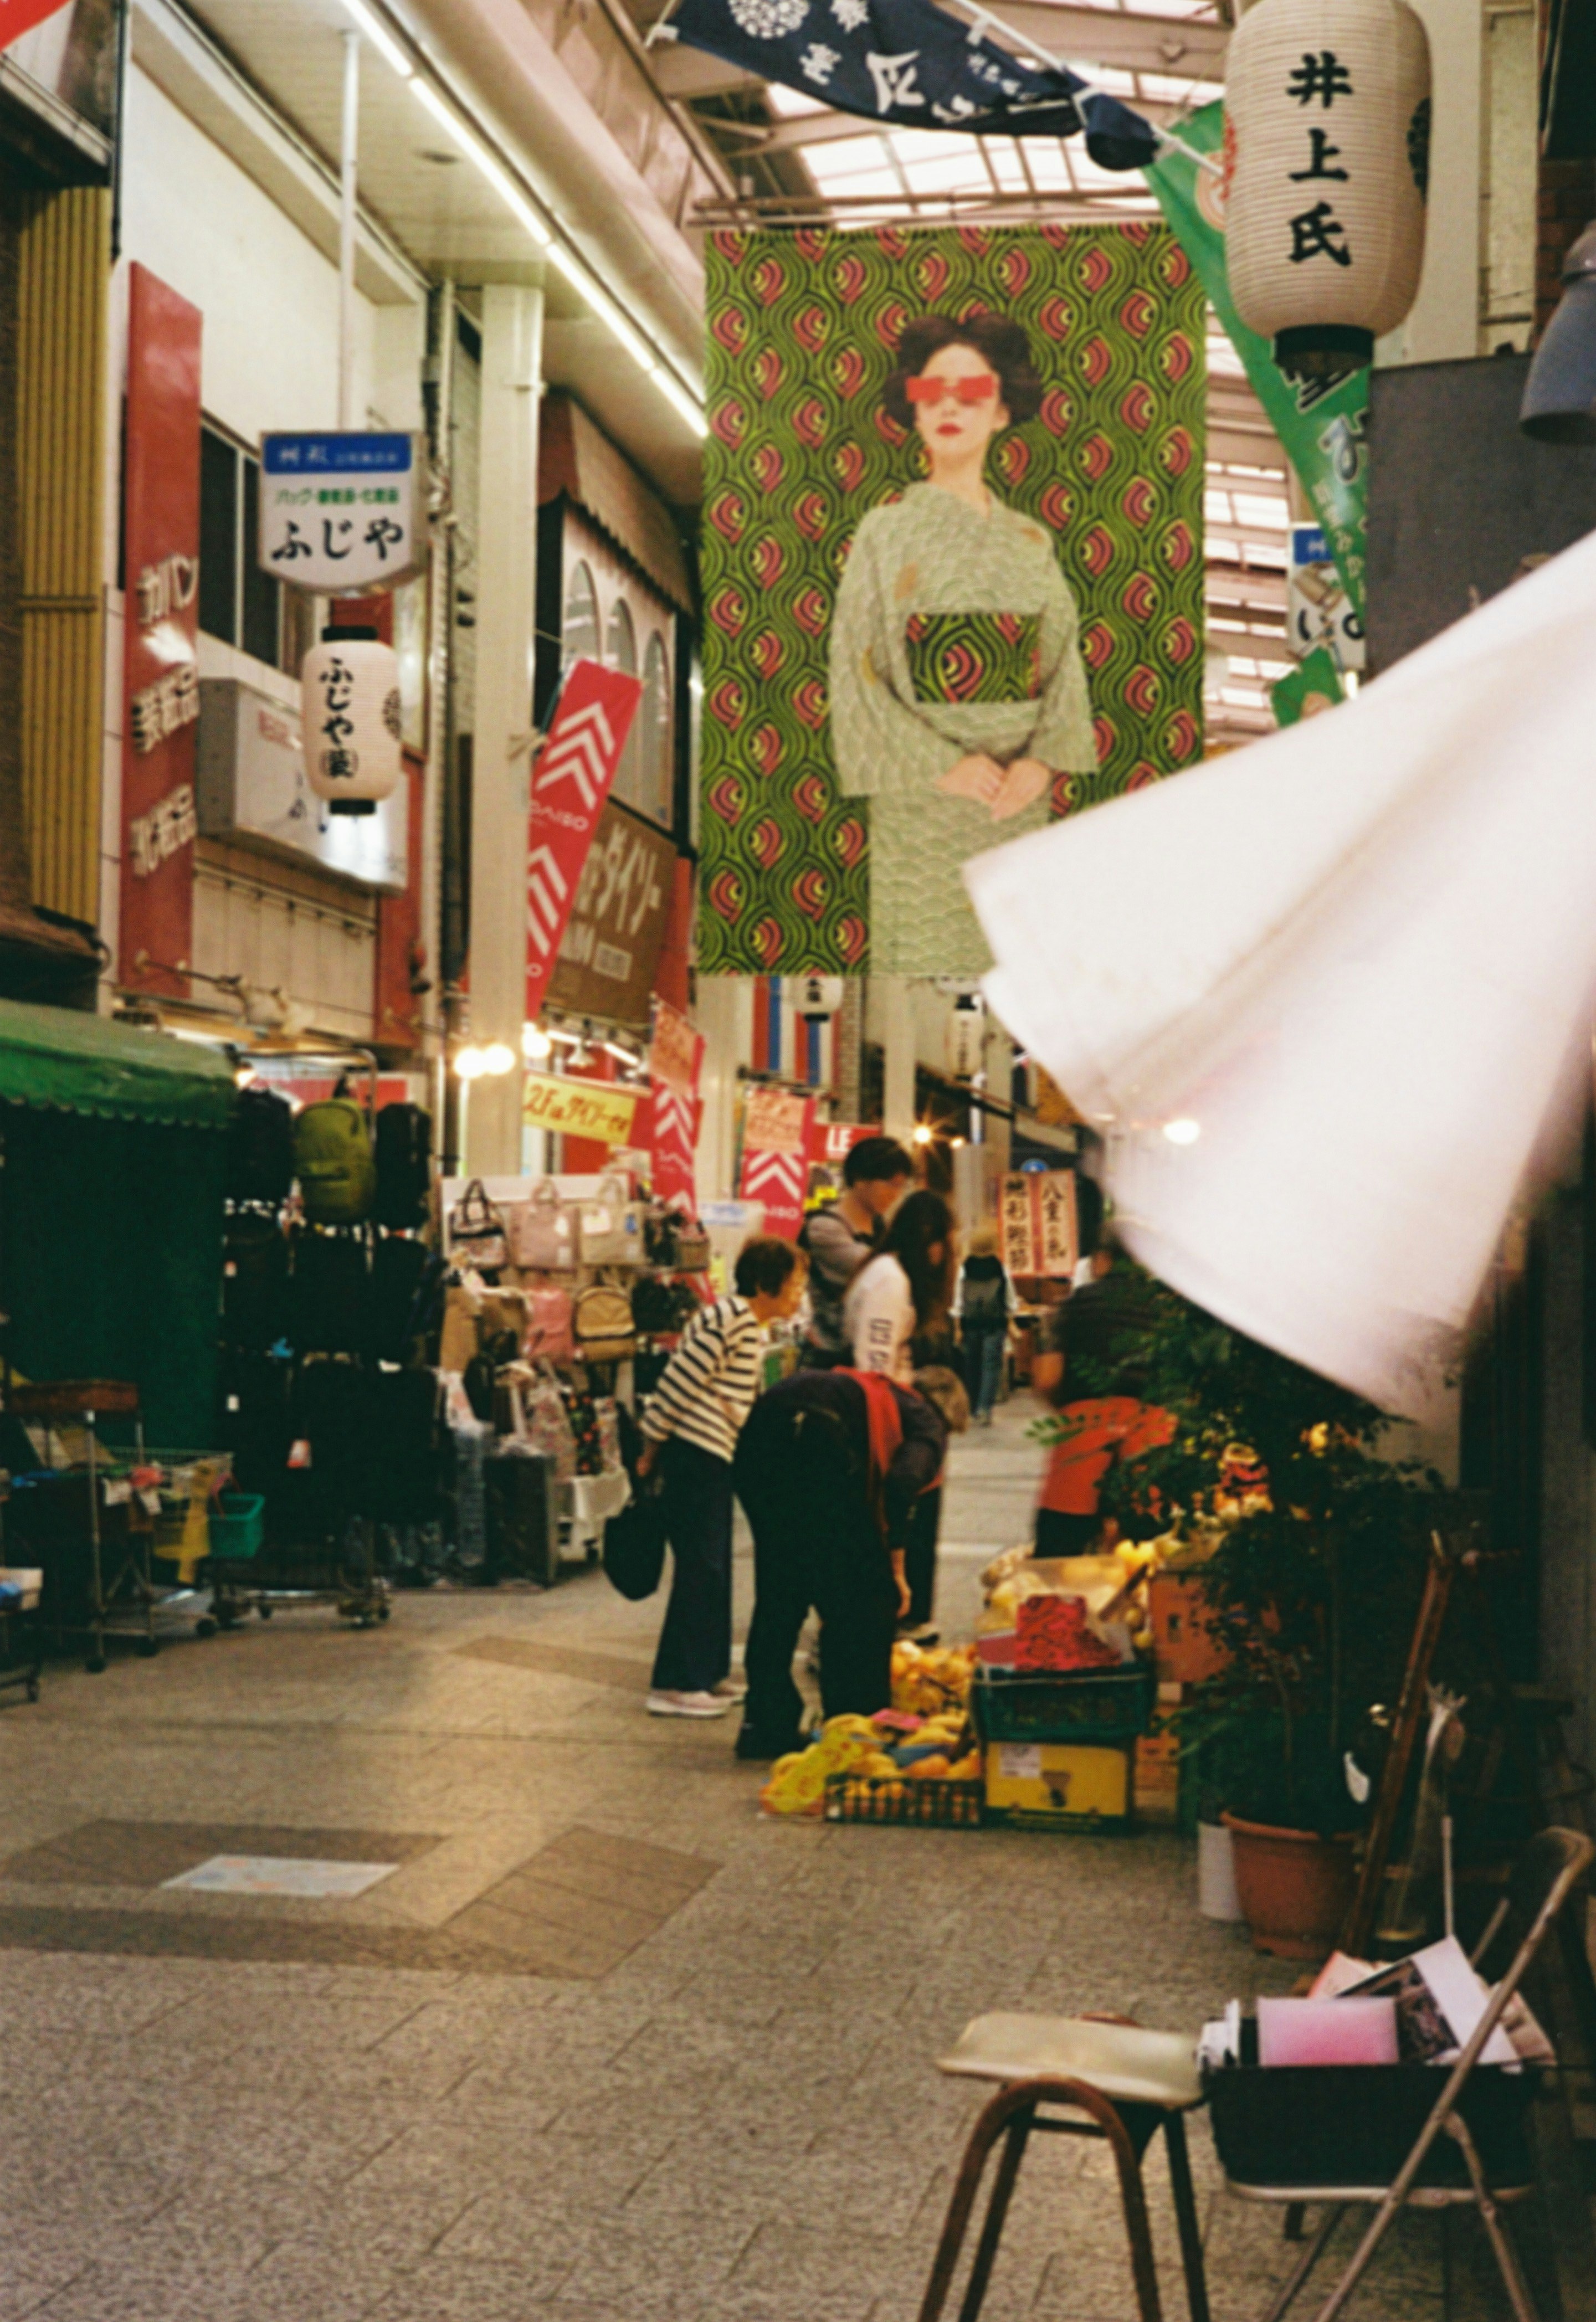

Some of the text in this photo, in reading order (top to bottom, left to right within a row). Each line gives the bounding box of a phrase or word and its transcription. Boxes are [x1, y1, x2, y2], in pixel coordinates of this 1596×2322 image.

[1286, 50, 1354, 268] 井上氏
[271, 516, 404, 561] ふじや
